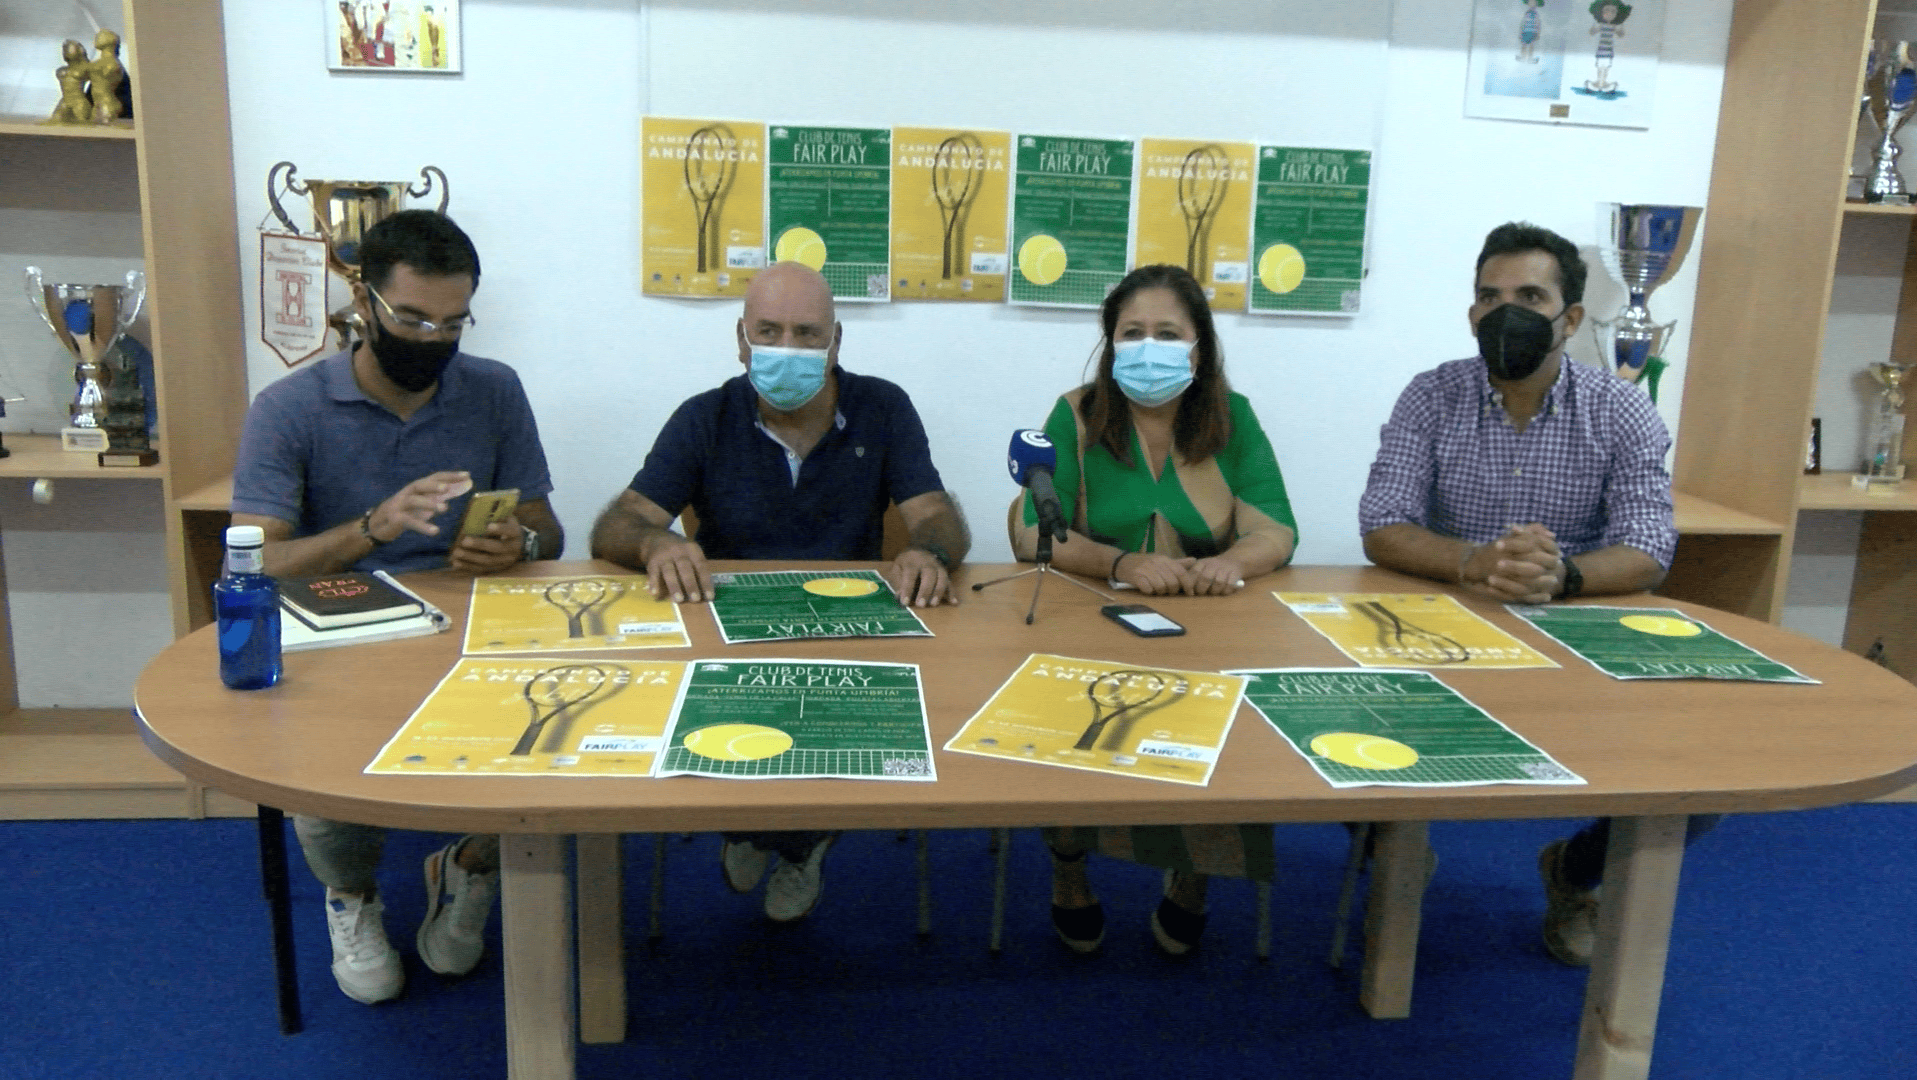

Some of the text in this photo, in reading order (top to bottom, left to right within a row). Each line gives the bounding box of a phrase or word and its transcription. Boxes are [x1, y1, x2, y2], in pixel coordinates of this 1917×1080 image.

[793, 143, 867, 164] FAIR PLAY
[1039, 153, 1111, 174] FAIR PLAY
[1279, 162, 1350, 184] FAIR PLAY
[766, 623, 824, 634] PLAY
[830, 621, 885, 632] FAIR
[749, 666, 863, 677] CLUB DE TENIS
[737, 674, 873, 687] FAIR PLAY
[1277, 683, 1407, 695] FAIR PLAY
